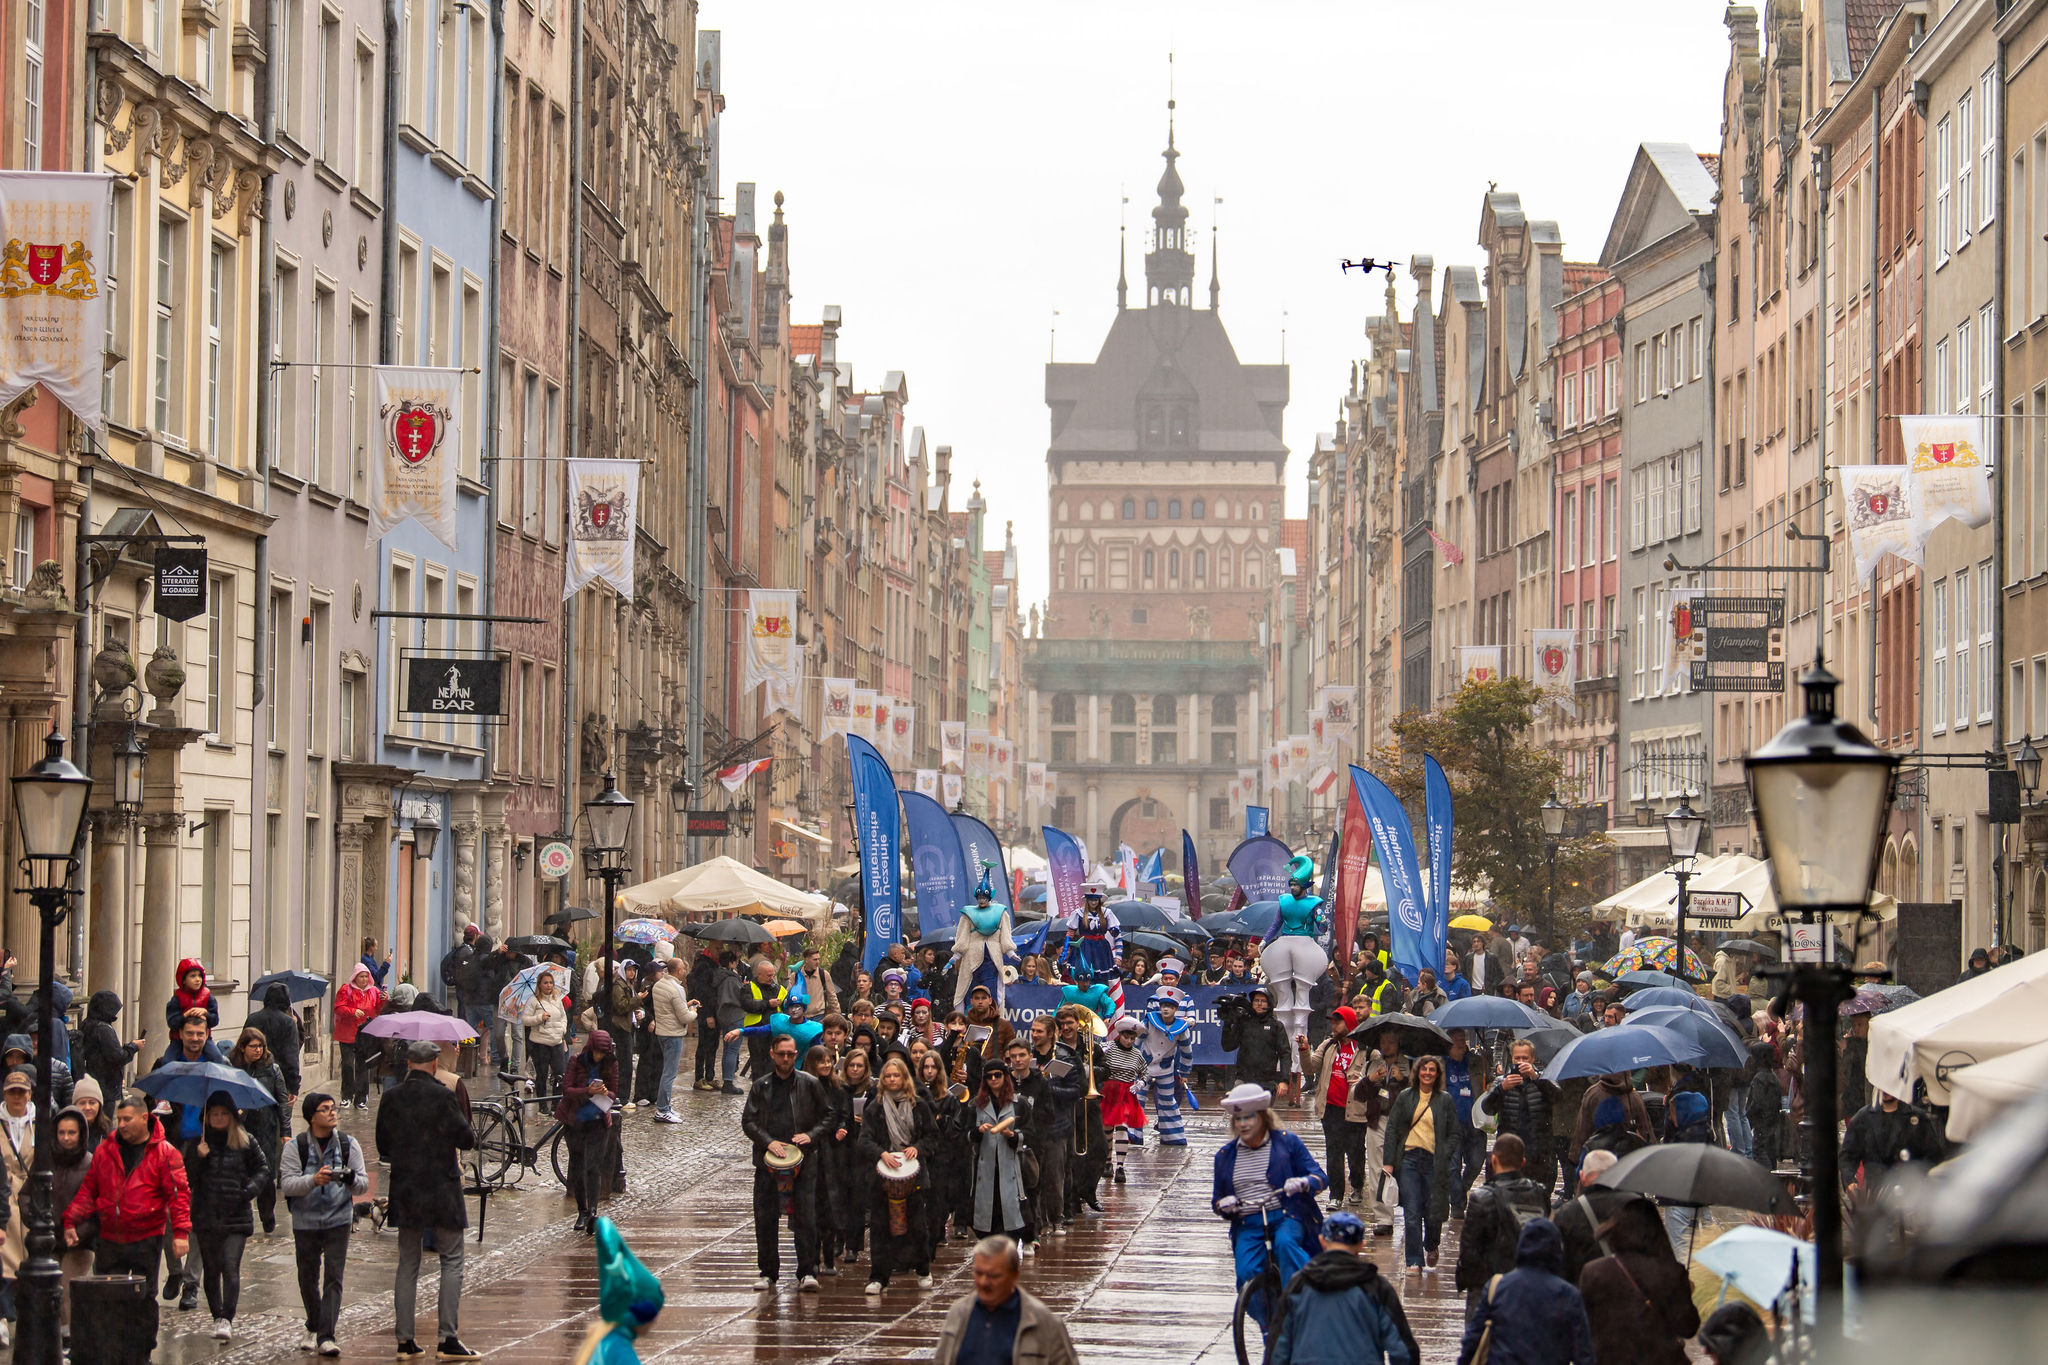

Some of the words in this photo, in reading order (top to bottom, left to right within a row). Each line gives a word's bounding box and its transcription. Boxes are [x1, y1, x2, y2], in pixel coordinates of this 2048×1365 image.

[168, 586, 199, 594] GDAŃSKU
[1712, 636, 1764, 649] Hampton
[438, 686, 471, 699] NEPTUN
[432, 699, 476, 711] BAR
